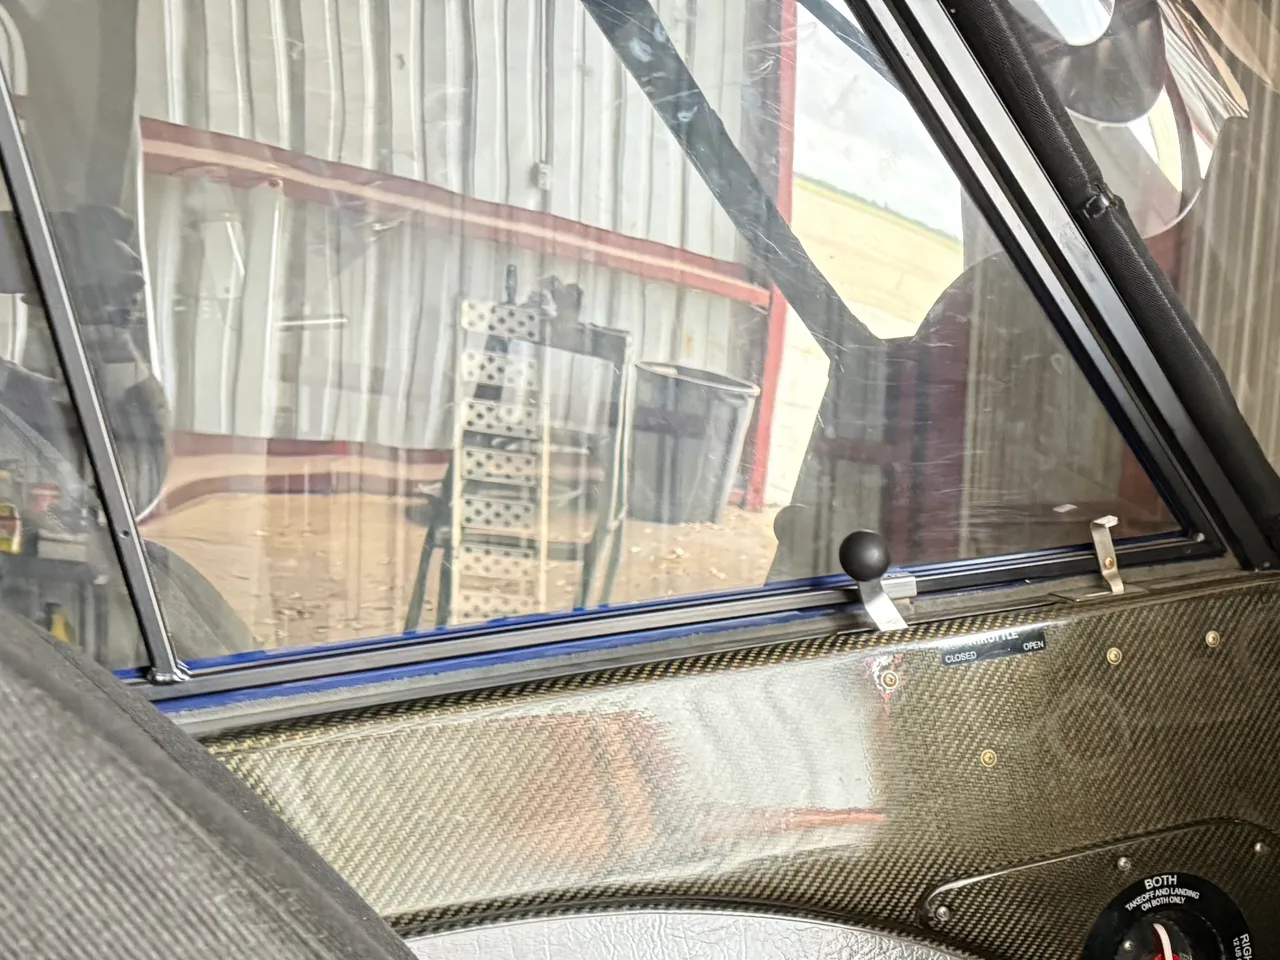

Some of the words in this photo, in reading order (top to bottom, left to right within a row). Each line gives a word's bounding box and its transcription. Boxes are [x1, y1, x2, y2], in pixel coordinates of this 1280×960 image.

[945, 652, 977, 663] CLOSED
[1023, 641, 1044, 650] OPEN
[1144, 874, 1177, 890] BOTH
[1124, 890, 1154, 911] TAKEOFF
[1155, 888, 1170, 896] AND
[1170, 887, 1200, 900] LANDING
[1141, 902, 1152, 911] ON
[1152, 897, 1168, 906] BOTH
[1169, 896, 1186, 904] ONLY
[1233, 938, 1240, 946] 12
[1234, 948, 1242, 958] US
